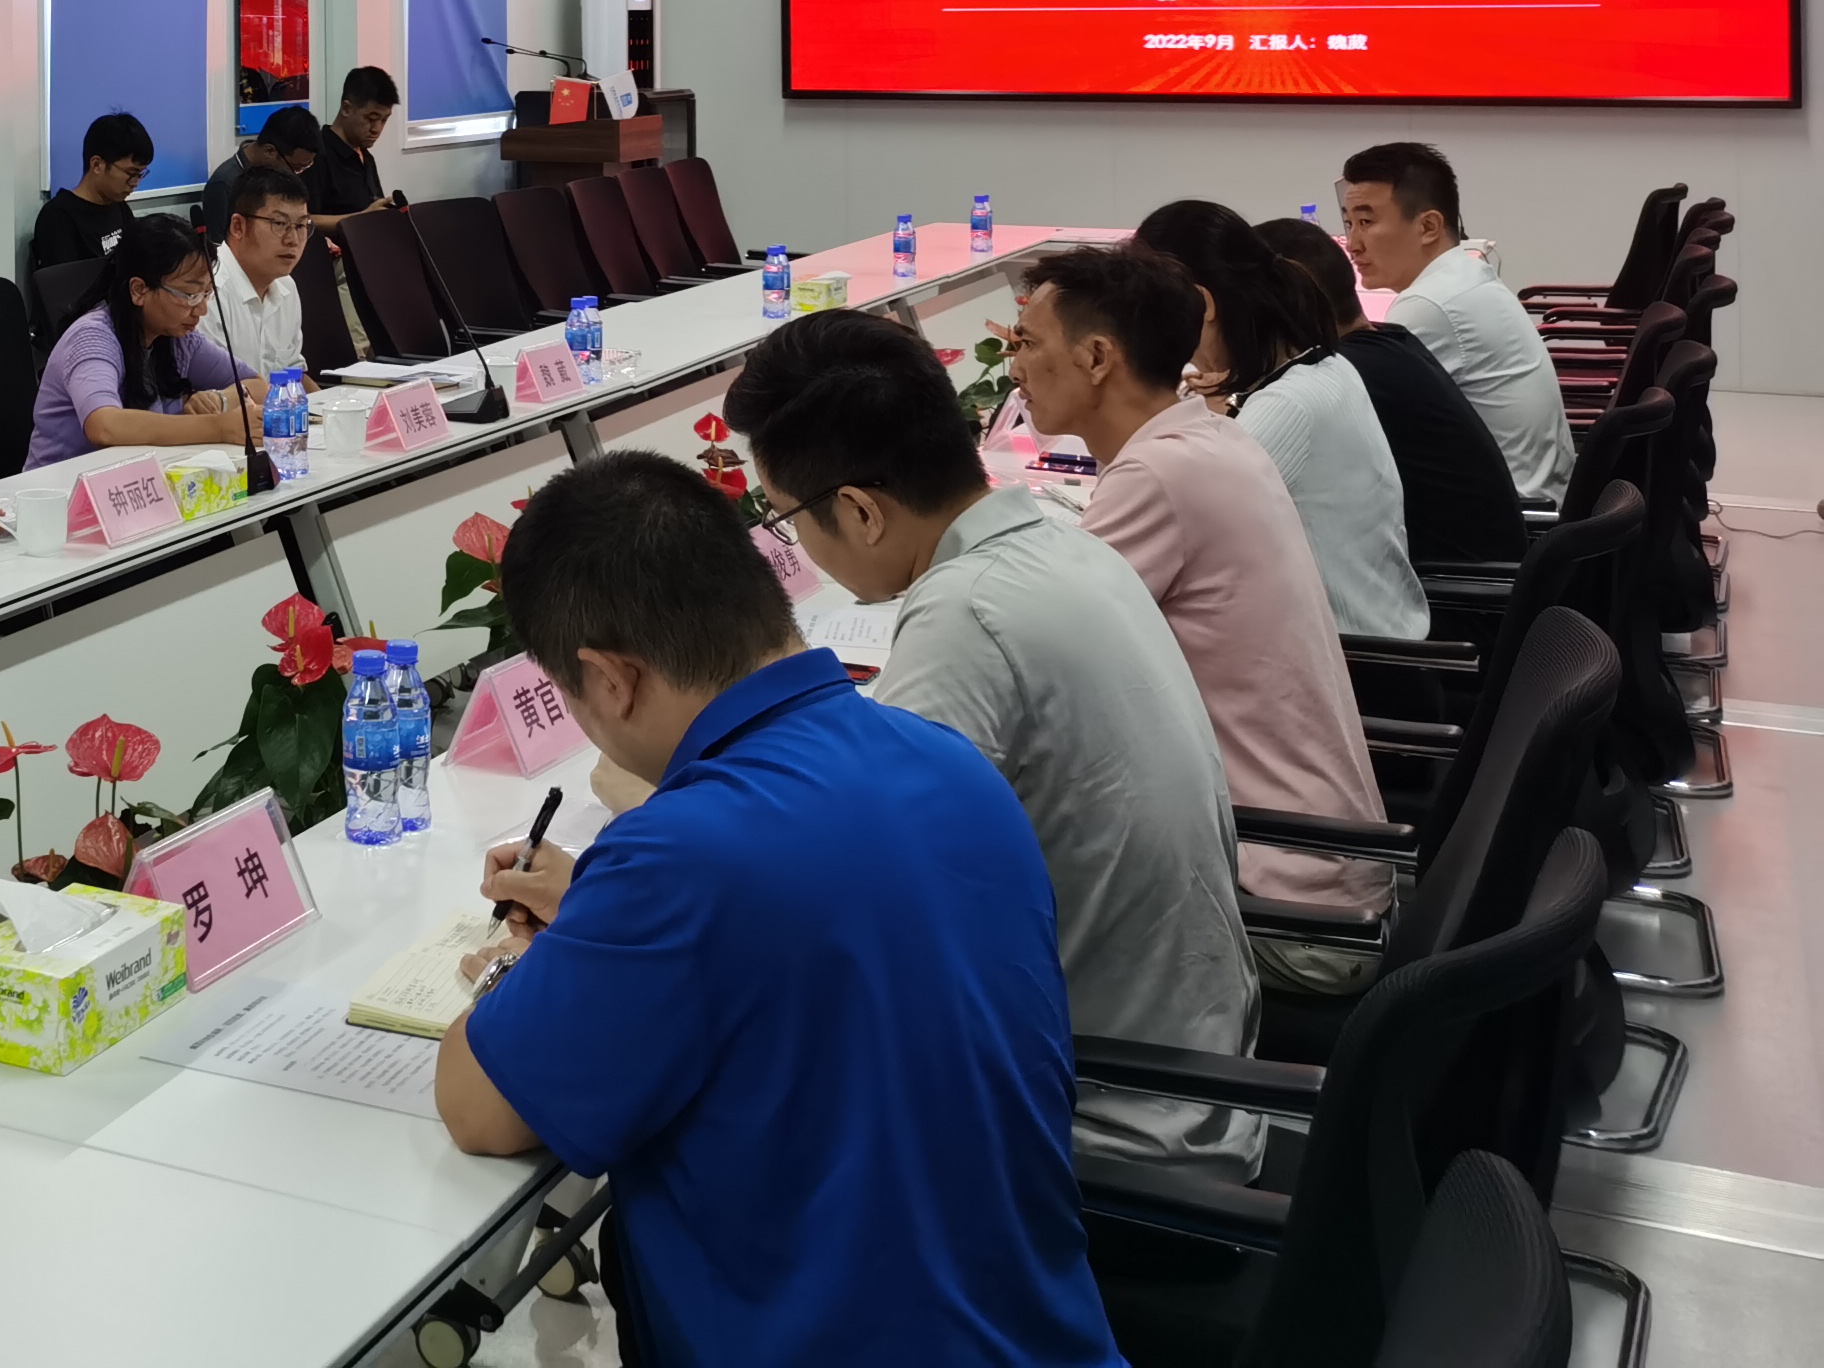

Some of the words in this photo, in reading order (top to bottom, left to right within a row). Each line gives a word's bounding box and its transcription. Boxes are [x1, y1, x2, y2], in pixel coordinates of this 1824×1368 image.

[1143, 33, 1235, 51] 2022年9月
[399, 401, 438, 434] 刘美蓉
[107, 474, 164, 517] 钟丽红
[765, 544, 802, 582] 俊勇
[513, 677, 569, 739] 黄官
[181, 847, 269, 944] 罗坤
[105, 947, 152, 991] Weibrand
